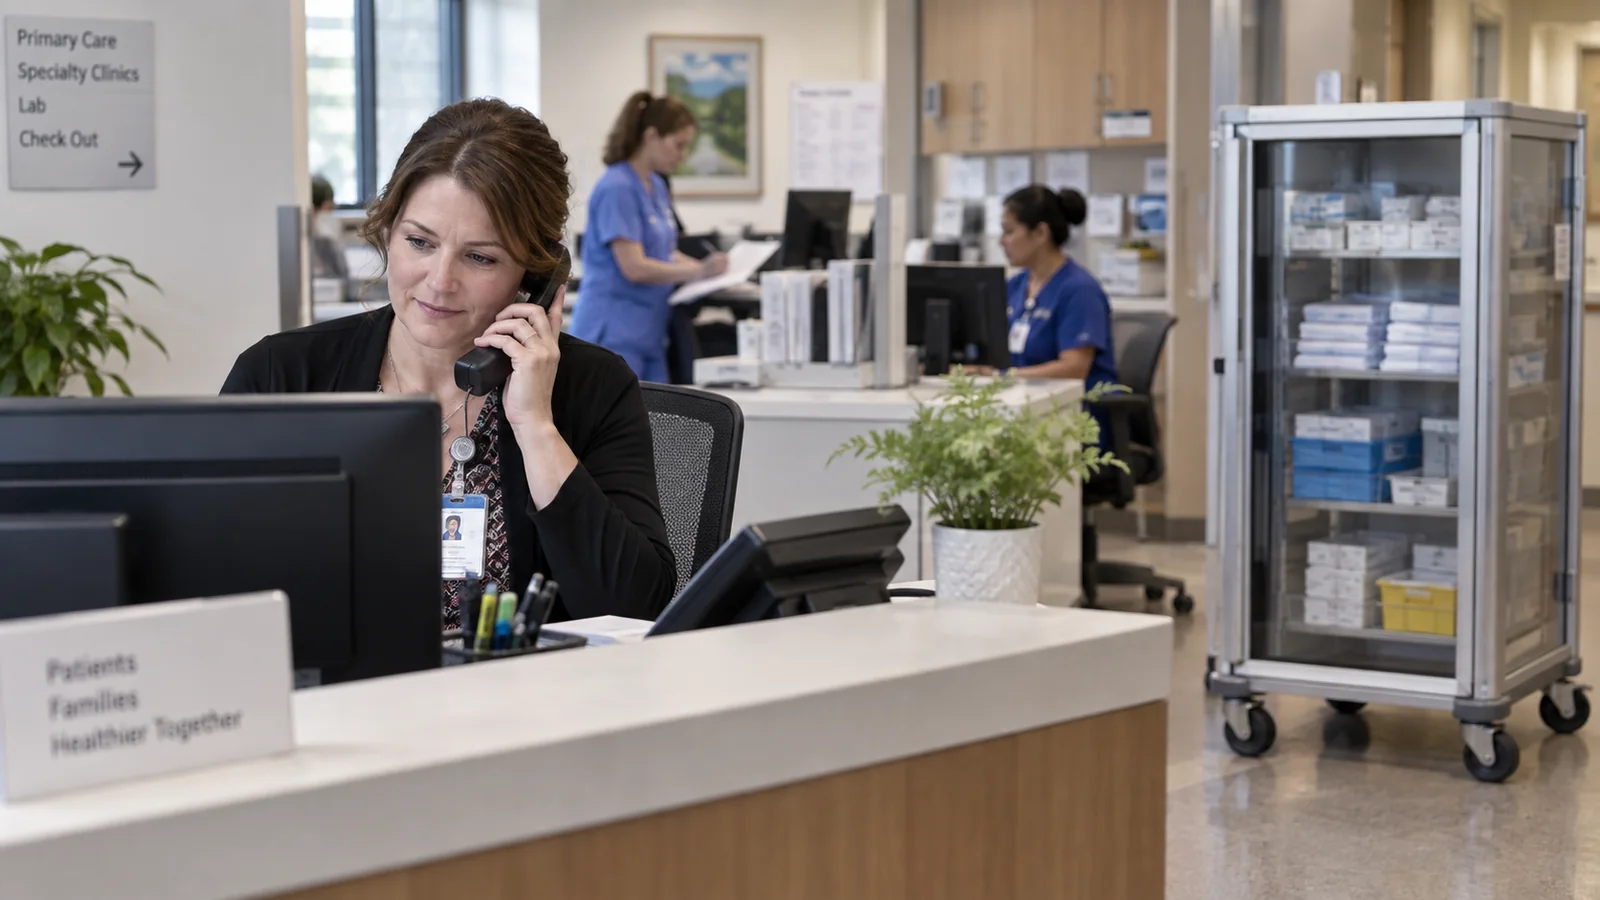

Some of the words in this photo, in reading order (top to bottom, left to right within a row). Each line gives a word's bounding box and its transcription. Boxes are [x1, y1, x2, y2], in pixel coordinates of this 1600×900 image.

[17, 28, 77, 51] Primary
[82, 30, 117, 49] Care
[18, 62, 87, 85] Specialty
[91, 64, 140, 82] Clinics
[18, 97, 46, 114] Lab
[19, 130, 66, 148] Check
[70, 130, 98, 148] Out
[46, 654, 138, 683] Patients
[50, 690, 139, 719] Families
[51, 725, 147, 757] Healthier
[153, 710, 243, 742] Together
